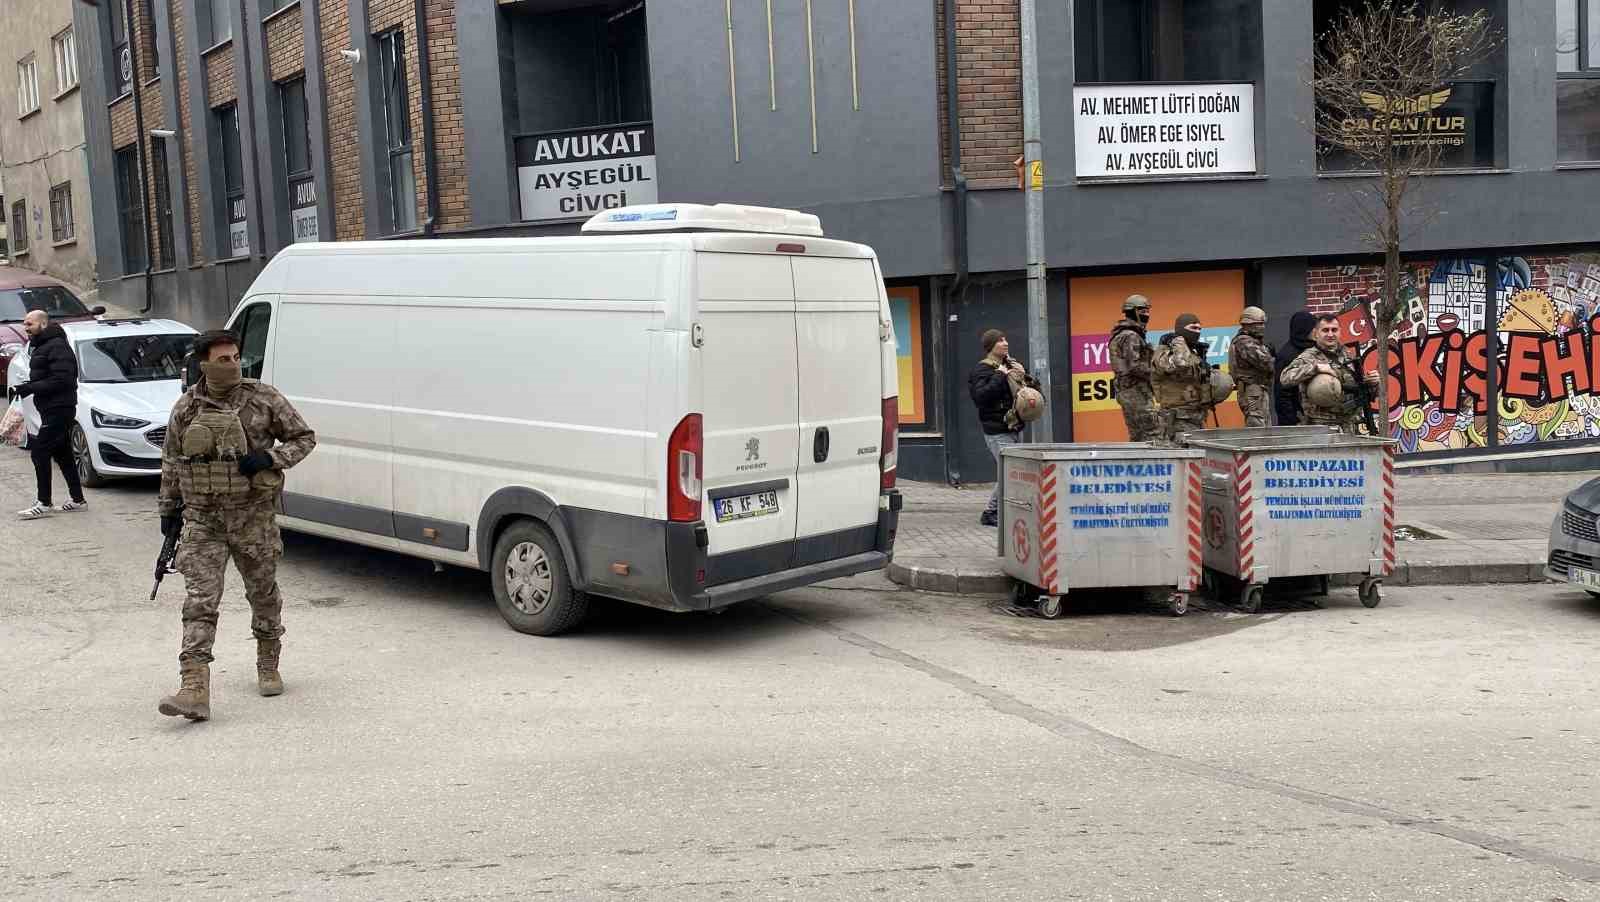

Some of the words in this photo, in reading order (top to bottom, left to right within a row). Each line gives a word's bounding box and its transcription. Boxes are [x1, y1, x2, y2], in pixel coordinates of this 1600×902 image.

[1080, 97, 1099, 116] AV.
[1103, 96, 1158, 115] MEHMET
[1162, 92, 1195, 114] LÜTFİ
[1199, 90, 1240, 113] DOĞAN
[1098, 126, 1117, 144] AV.
[1120, 123, 1157, 143] ÖMER
[1160, 125, 1183, 142] EGE
[534, 130, 646, 161] AVUKAT
[1105, 153, 1124, 171] AV.
[1128, 149, 1183, 173] AYŞEGÜL
[1187, 147, 1218, 168] CİVCİ
[534, 163, 651, 190] AYŞEGÜL
[296, 181, 316, 206] AVUK
[559, 189, 627, 213] CİVCİ
[735, 462, 768, 471] PEUGEOT
[1070, 463, 1172, 477] ODUNPAZARI
[1264, 458, 1365, 472] ODUNPAZARI
[1070, 480, 1171, 494] BELEDİYESİ
[1264, 475, 1365, 488] BELEDİYESİ
[722, 500, 734, 515] 26
[740, 496, 752, 513] KF
